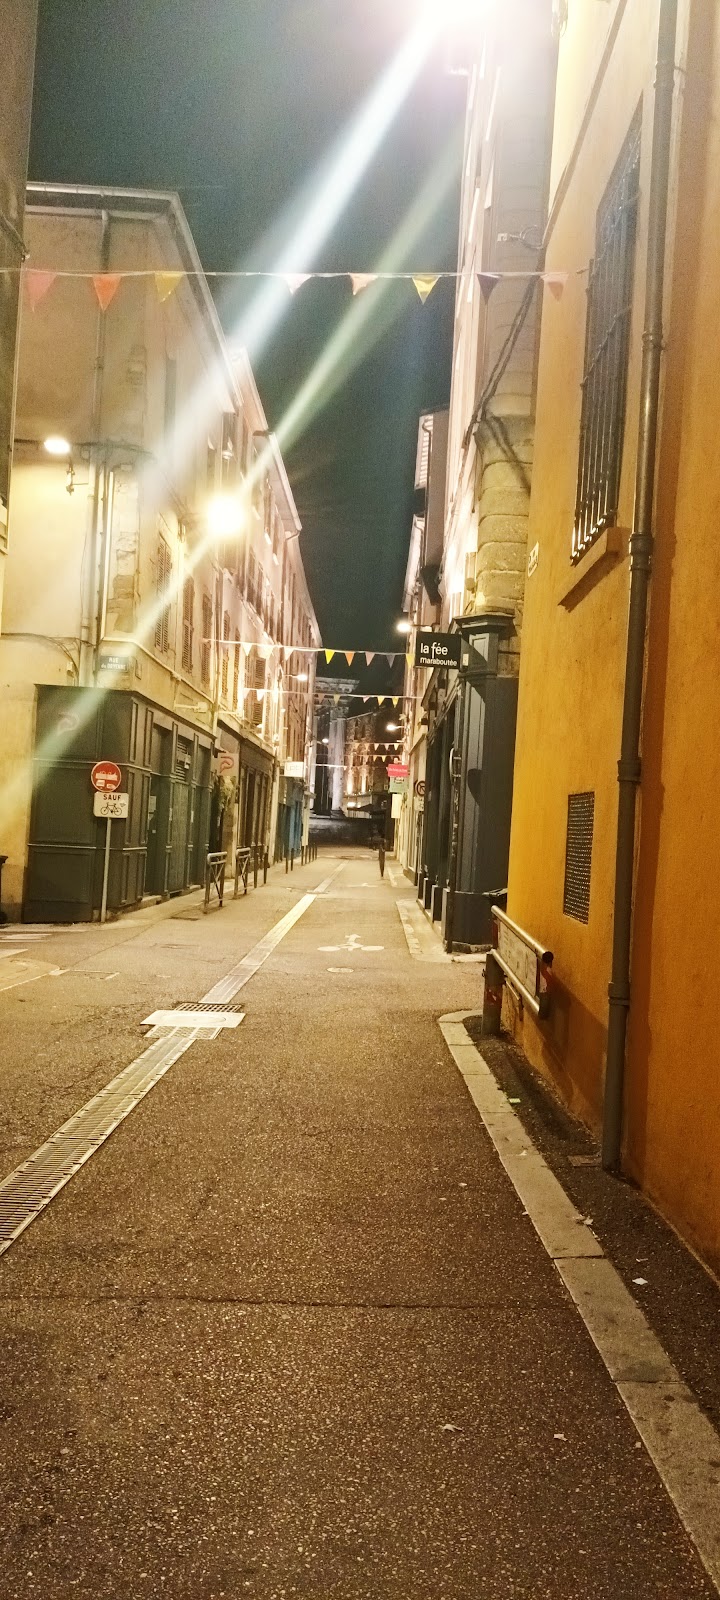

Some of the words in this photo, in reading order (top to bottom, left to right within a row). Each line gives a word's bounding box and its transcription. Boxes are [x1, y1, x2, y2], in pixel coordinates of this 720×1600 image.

[420, 642, 430, 654] la
[431, 641, 448, 659] fée
[420, 656, 458, 667] maraboutée
[103, 793, 122, 801] SAUF
